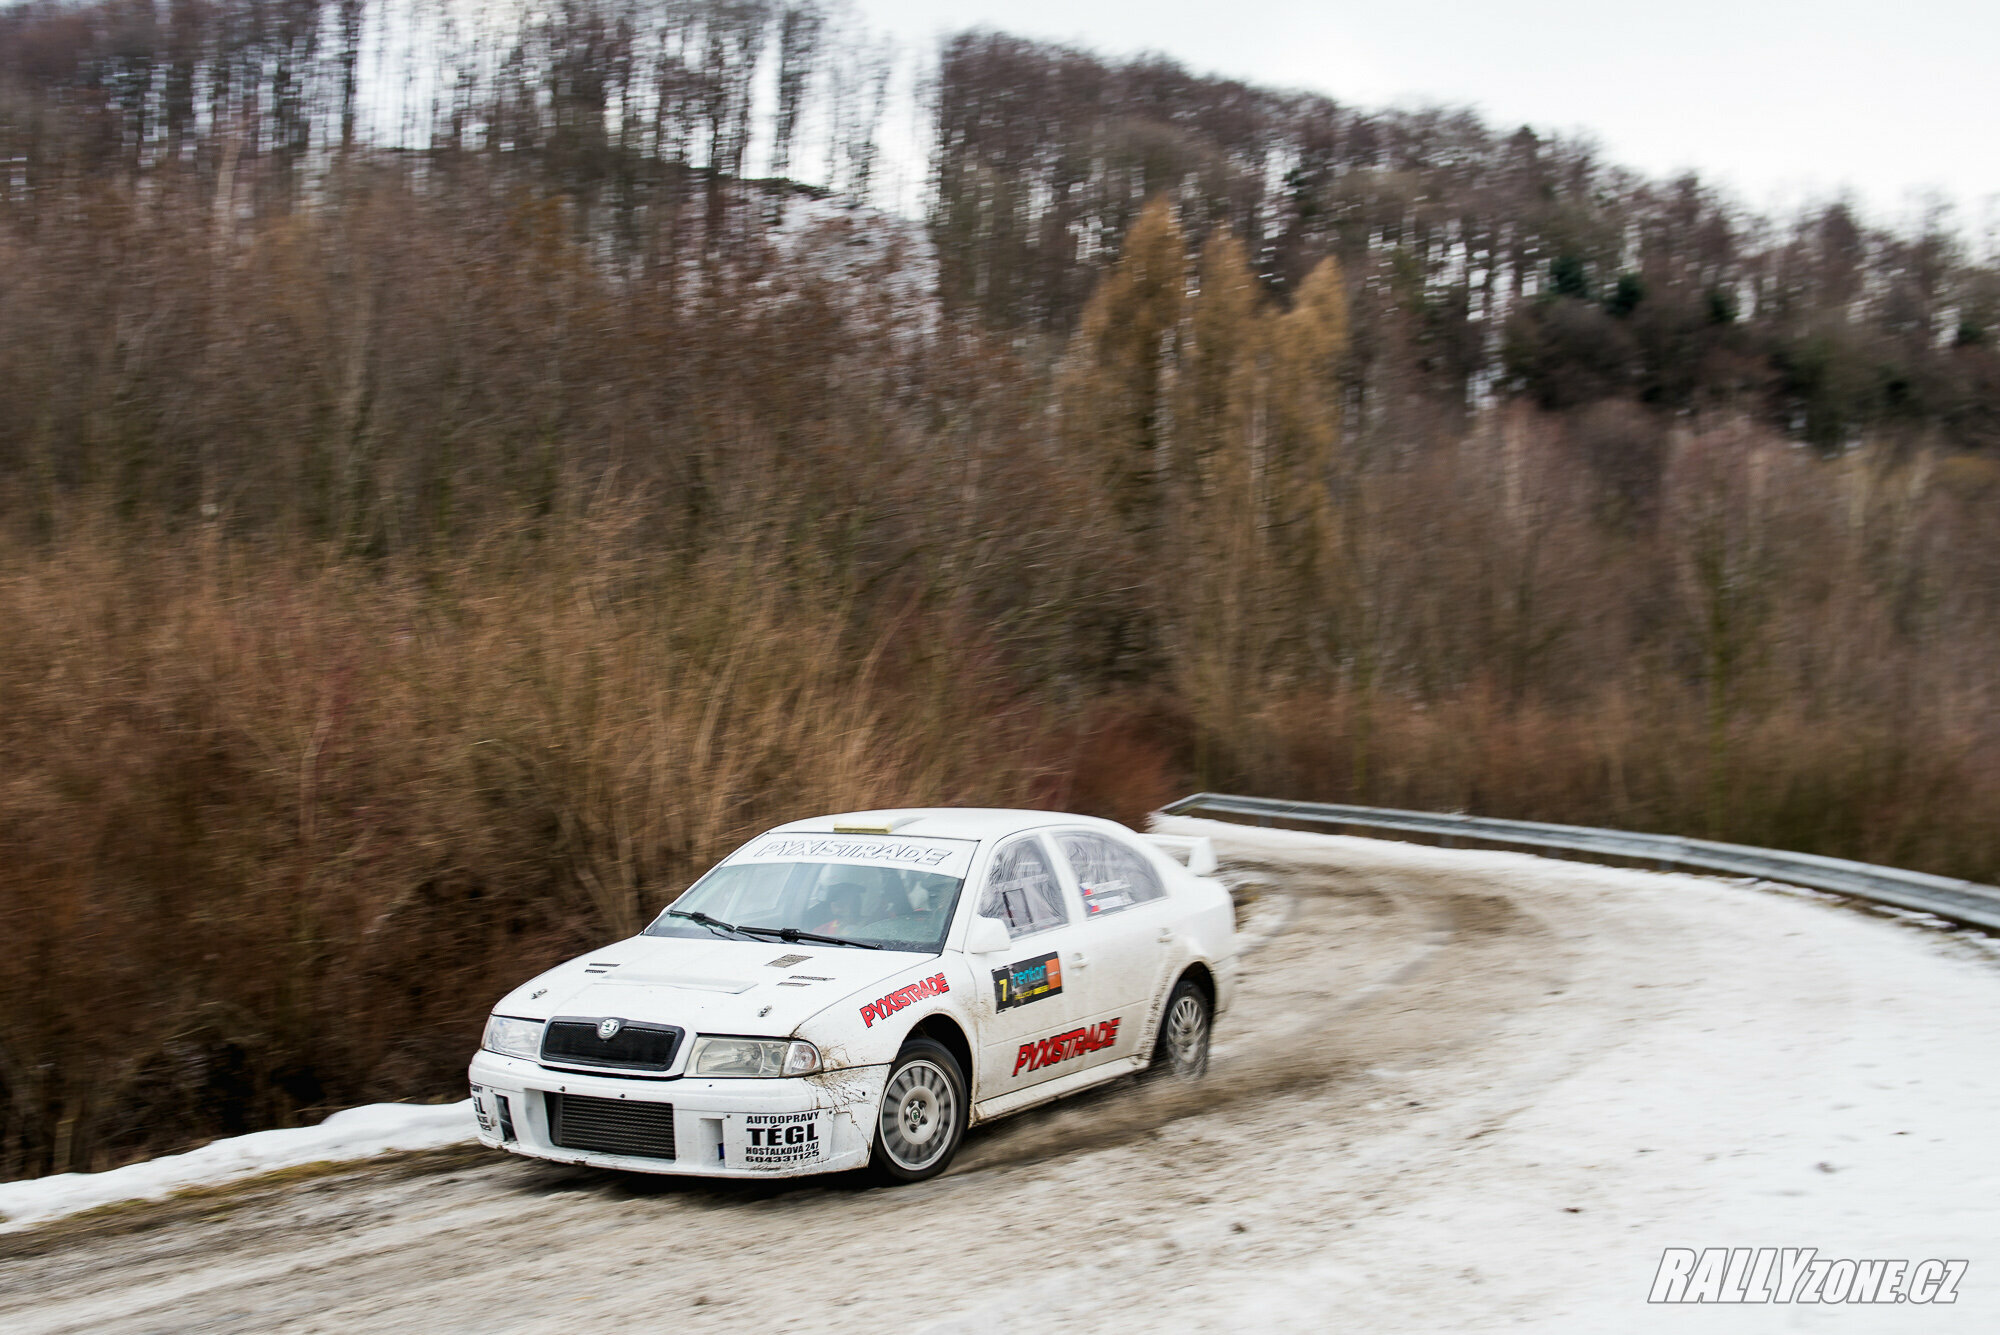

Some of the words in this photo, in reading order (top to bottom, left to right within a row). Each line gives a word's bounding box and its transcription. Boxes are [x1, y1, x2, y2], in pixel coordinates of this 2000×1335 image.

[754, 840, 952, 866] PYXISTRADE
[859, 972, 950, 1028] PYXISTRADE
[1012, 1017, 1121, 1077] PYXISTRADE
[746, 1111, 820, 1124] AUTOOPRAVY
[746, 1123, 819, 1146] TÉGL
[746, 1149, 819, 1162] 604331125
[805, 1142, 819, 1151] 247
